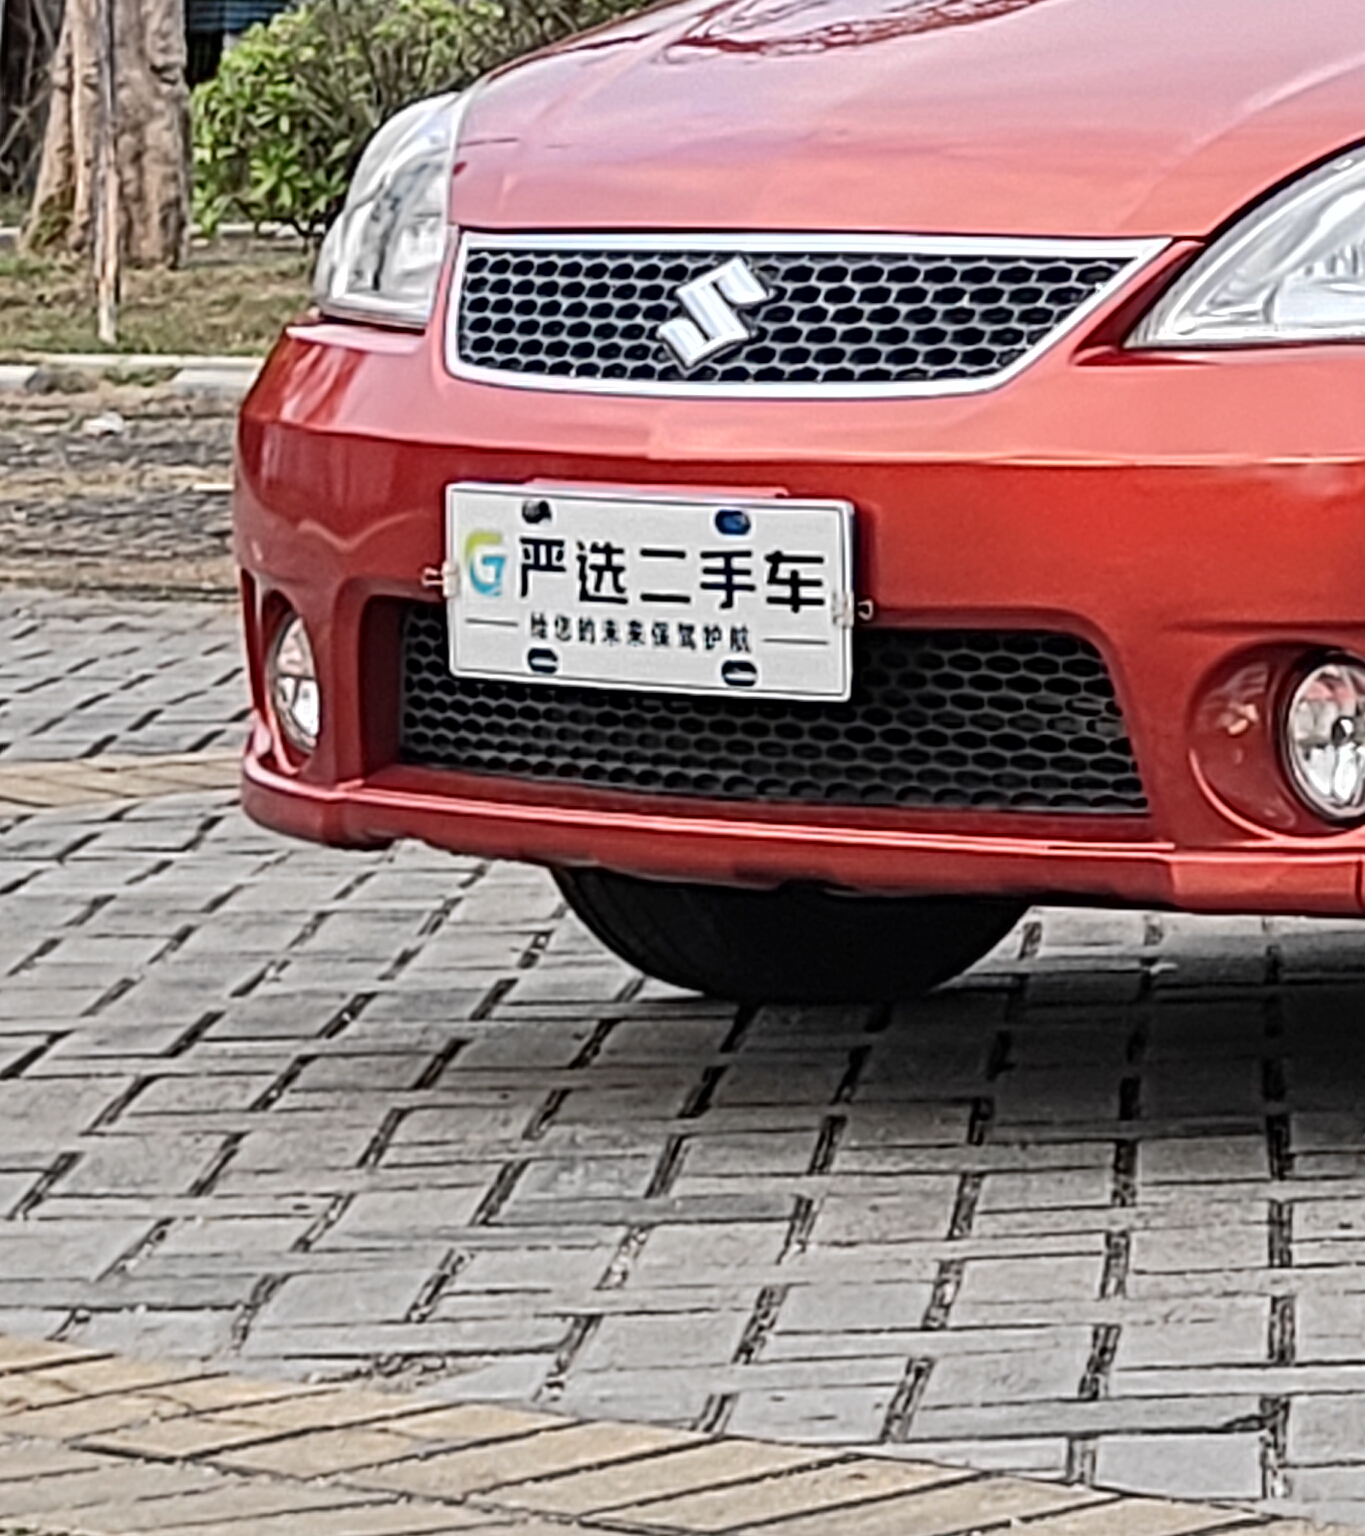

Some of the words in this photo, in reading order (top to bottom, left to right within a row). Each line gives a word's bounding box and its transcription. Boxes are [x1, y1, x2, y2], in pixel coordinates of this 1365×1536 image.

[519, 536, 825, 613] 严选二手车
[529, 611, 752, 653] 给您的未来保驾护航
